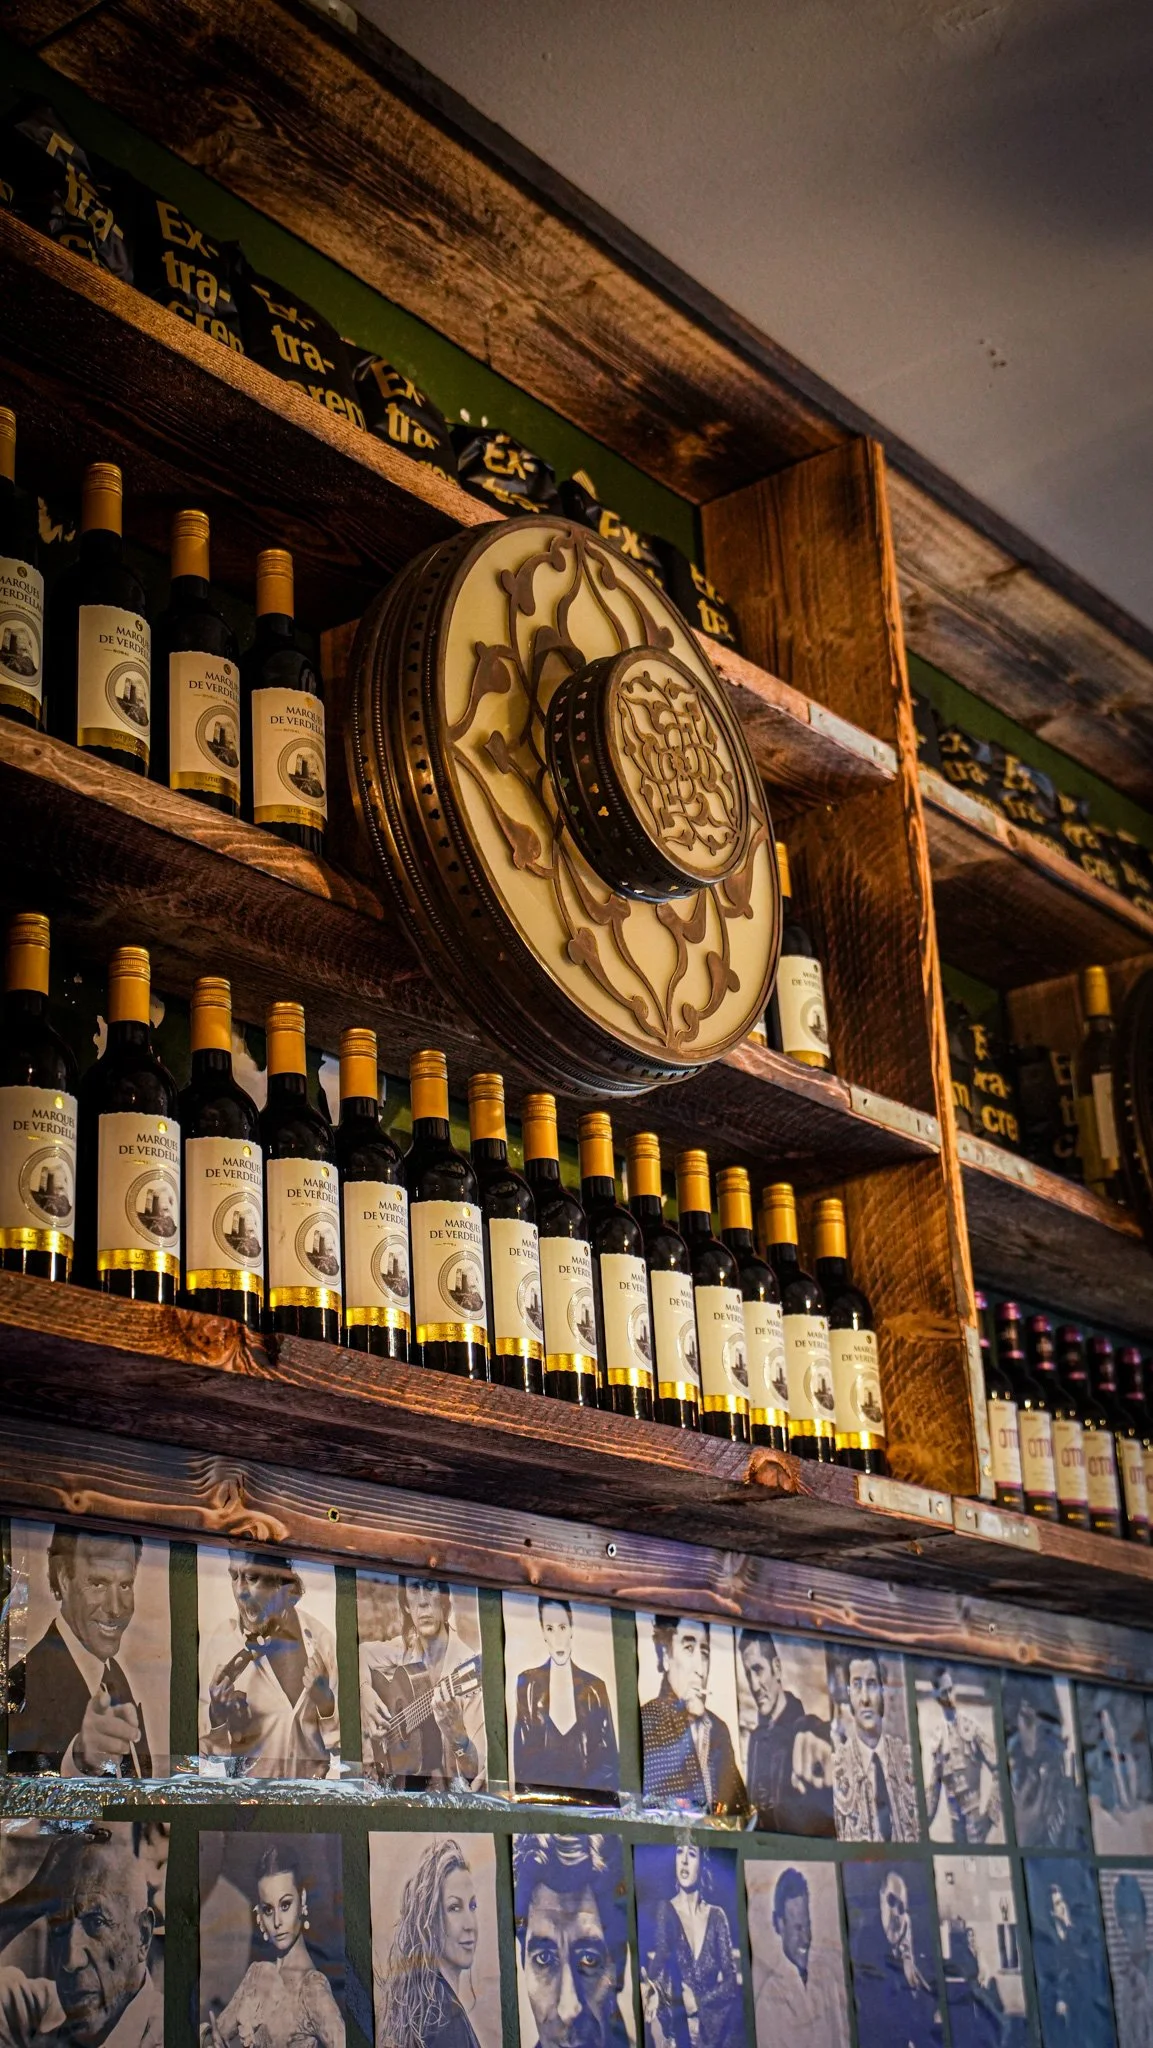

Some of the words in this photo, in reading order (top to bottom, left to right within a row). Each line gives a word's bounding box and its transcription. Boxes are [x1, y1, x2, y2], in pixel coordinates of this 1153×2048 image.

[156, 200, 219, 259] Ex-
[161, 250, 232, 308] tra-
[271, 324, 335, 375] tra-
[99, 634, 115, 645] DE
[189, 681, 203, 690] DE
[270, 716, 286, 725] DE
[13, 1120, 30, 1131] DE
[119, 1145, 135, 1155] DE
[205, 1168, 221, 1178] DE
[287, 1189, 302, 1198] DE
[363, 1211, 378, 1220] DE
[429, 1230, 444, 1239] DE
[509, 1247, 521, 1257] DE
[558, 1265, 571, 1274] DE
[619, 1281, 631, 1290] DE
[669, 1297, 681, 1306] DE
[713, 1312, 726, 1321] DE
[755, 1327, 766, 1335] DE
[795, 1340, 806, 1348] DE
[841, 1354, 853, 1362] DE
